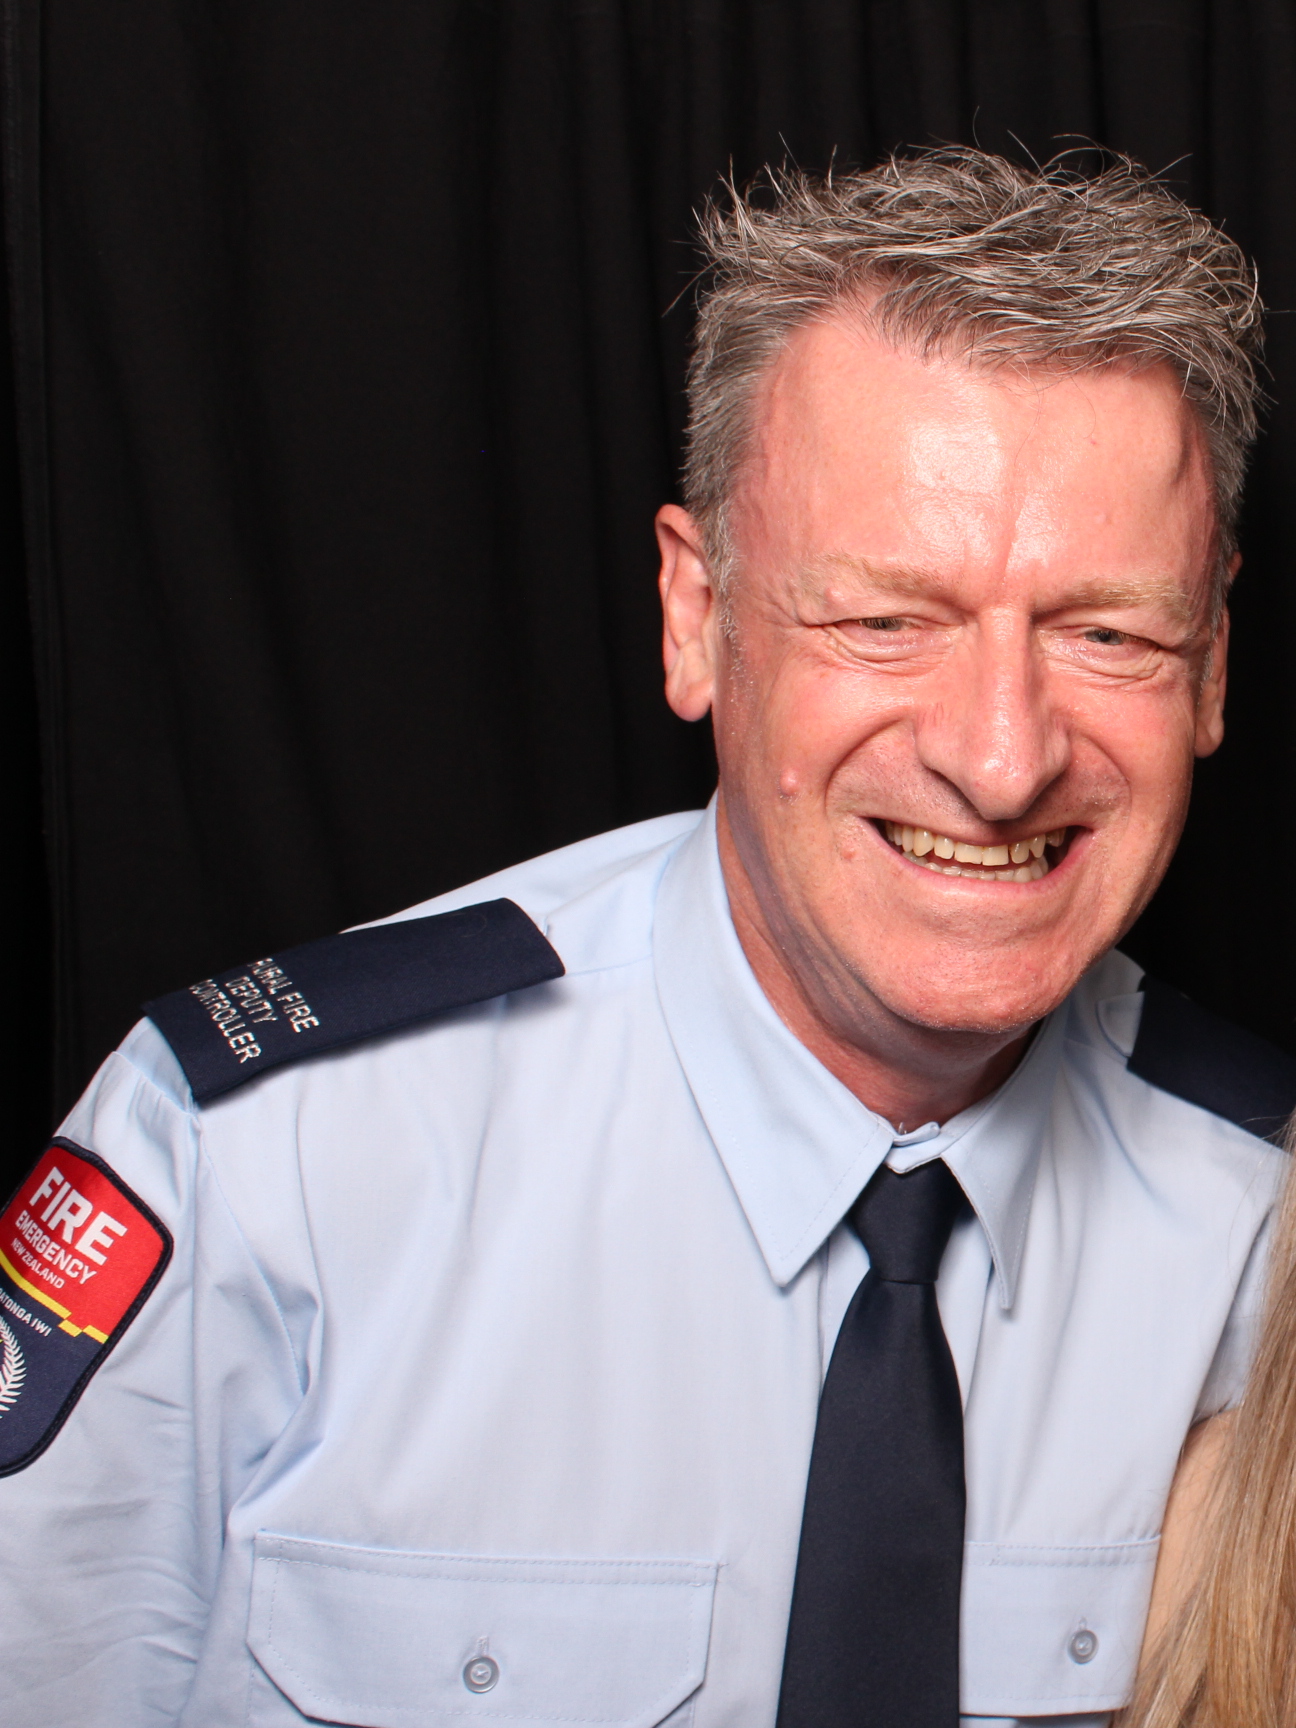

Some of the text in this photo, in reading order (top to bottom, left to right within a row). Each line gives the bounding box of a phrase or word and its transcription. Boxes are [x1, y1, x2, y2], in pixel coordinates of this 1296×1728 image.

[188, 978, 261, 1063] CONTROLLER
[225, 976, 279, 1023] DEPUTY
[247, 957, 320, 1033] RURAL FIRE
[15, 1210, 97, 1285] EMERGENCY
[29, 1166, 128, 1266] FIRE
[11, 1238, 65, 1289] NEW ZEALAND
[31, 1318, 52, 1337] IWI
